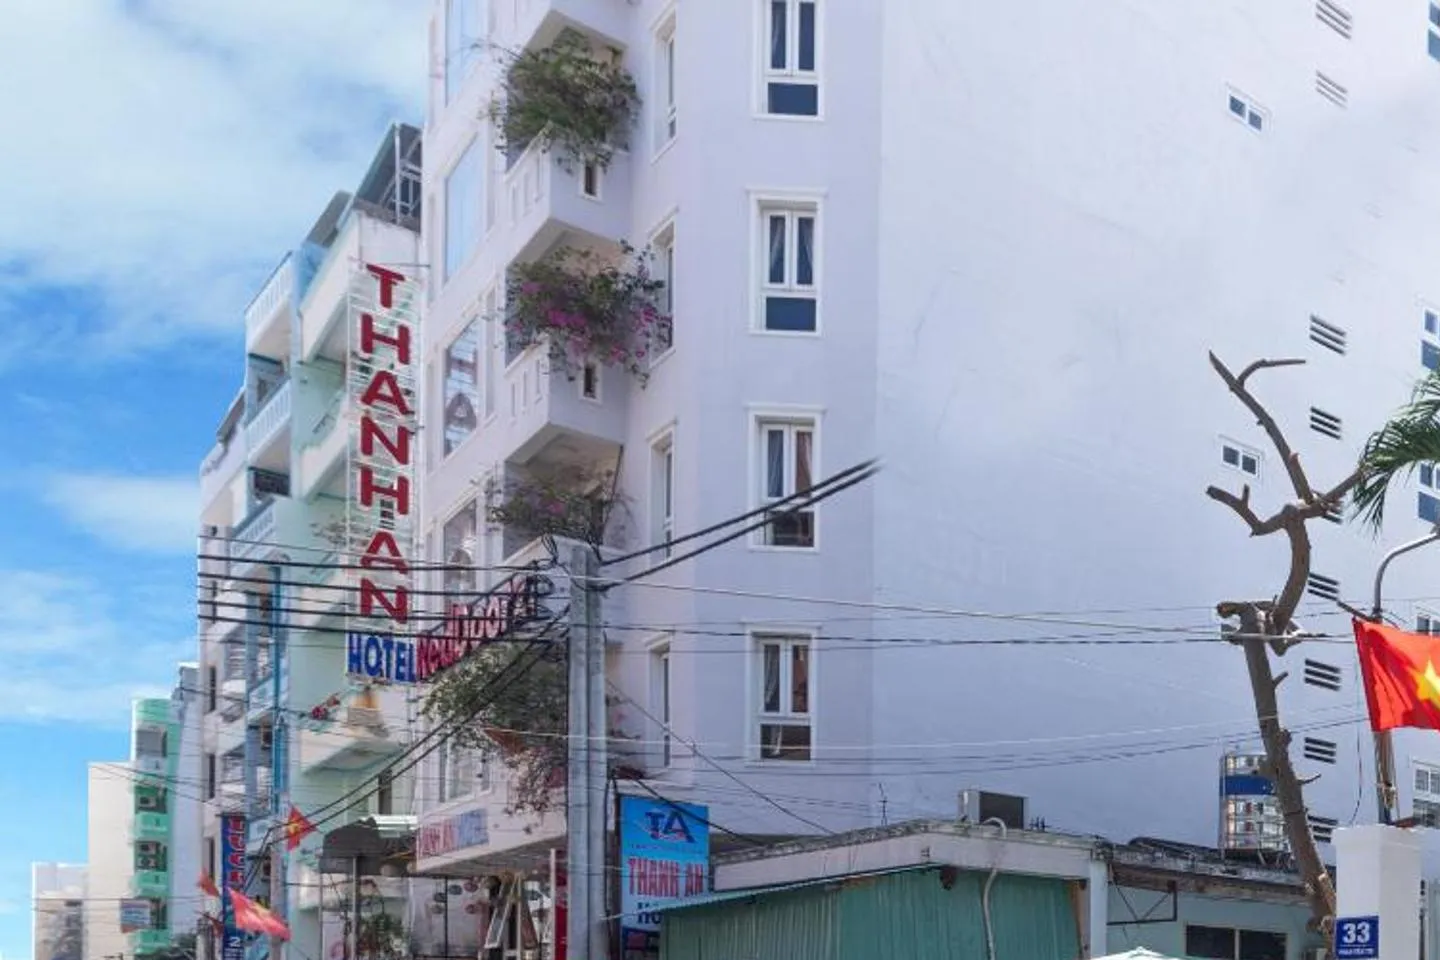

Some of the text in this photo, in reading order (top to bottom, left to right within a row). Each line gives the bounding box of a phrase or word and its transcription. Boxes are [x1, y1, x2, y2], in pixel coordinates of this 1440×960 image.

[360, 263, 412, 625] THANH AN
[348, 632, 416, 682] HOTEL
[645, 810, 696, 843] TA
[627, 855, 679, 898] THANH
[1342, 921, 1370, 944] 33
